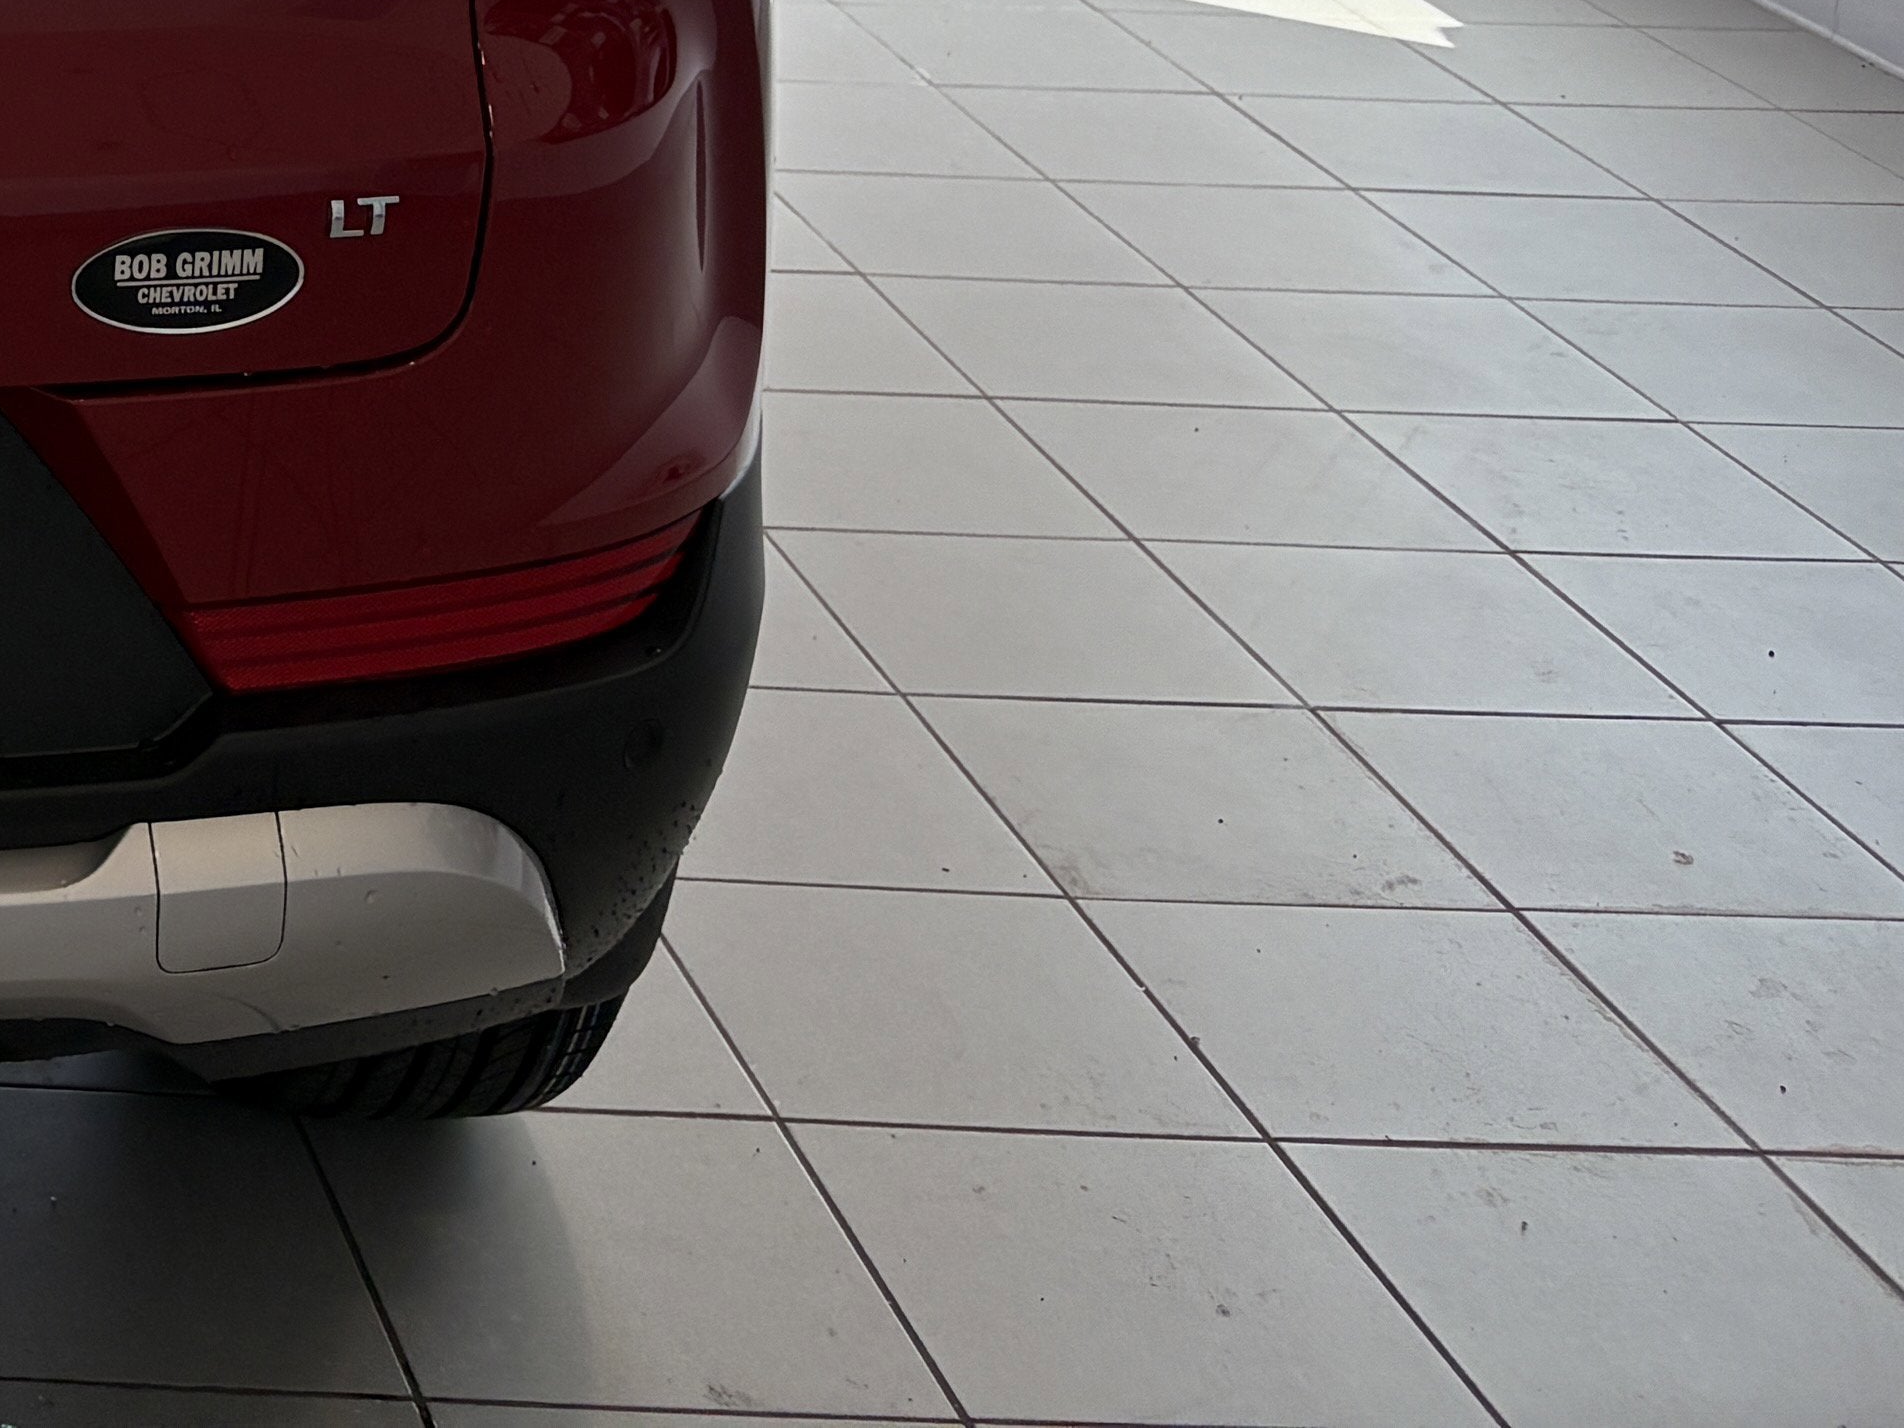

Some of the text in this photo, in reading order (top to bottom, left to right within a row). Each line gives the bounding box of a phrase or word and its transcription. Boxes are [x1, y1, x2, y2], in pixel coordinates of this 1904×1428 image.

[329, 195, 400, 238] LT
[114, 247, 265, 280] BOB GRIMM
[137, 282, 239, 304] CHEVROLET
